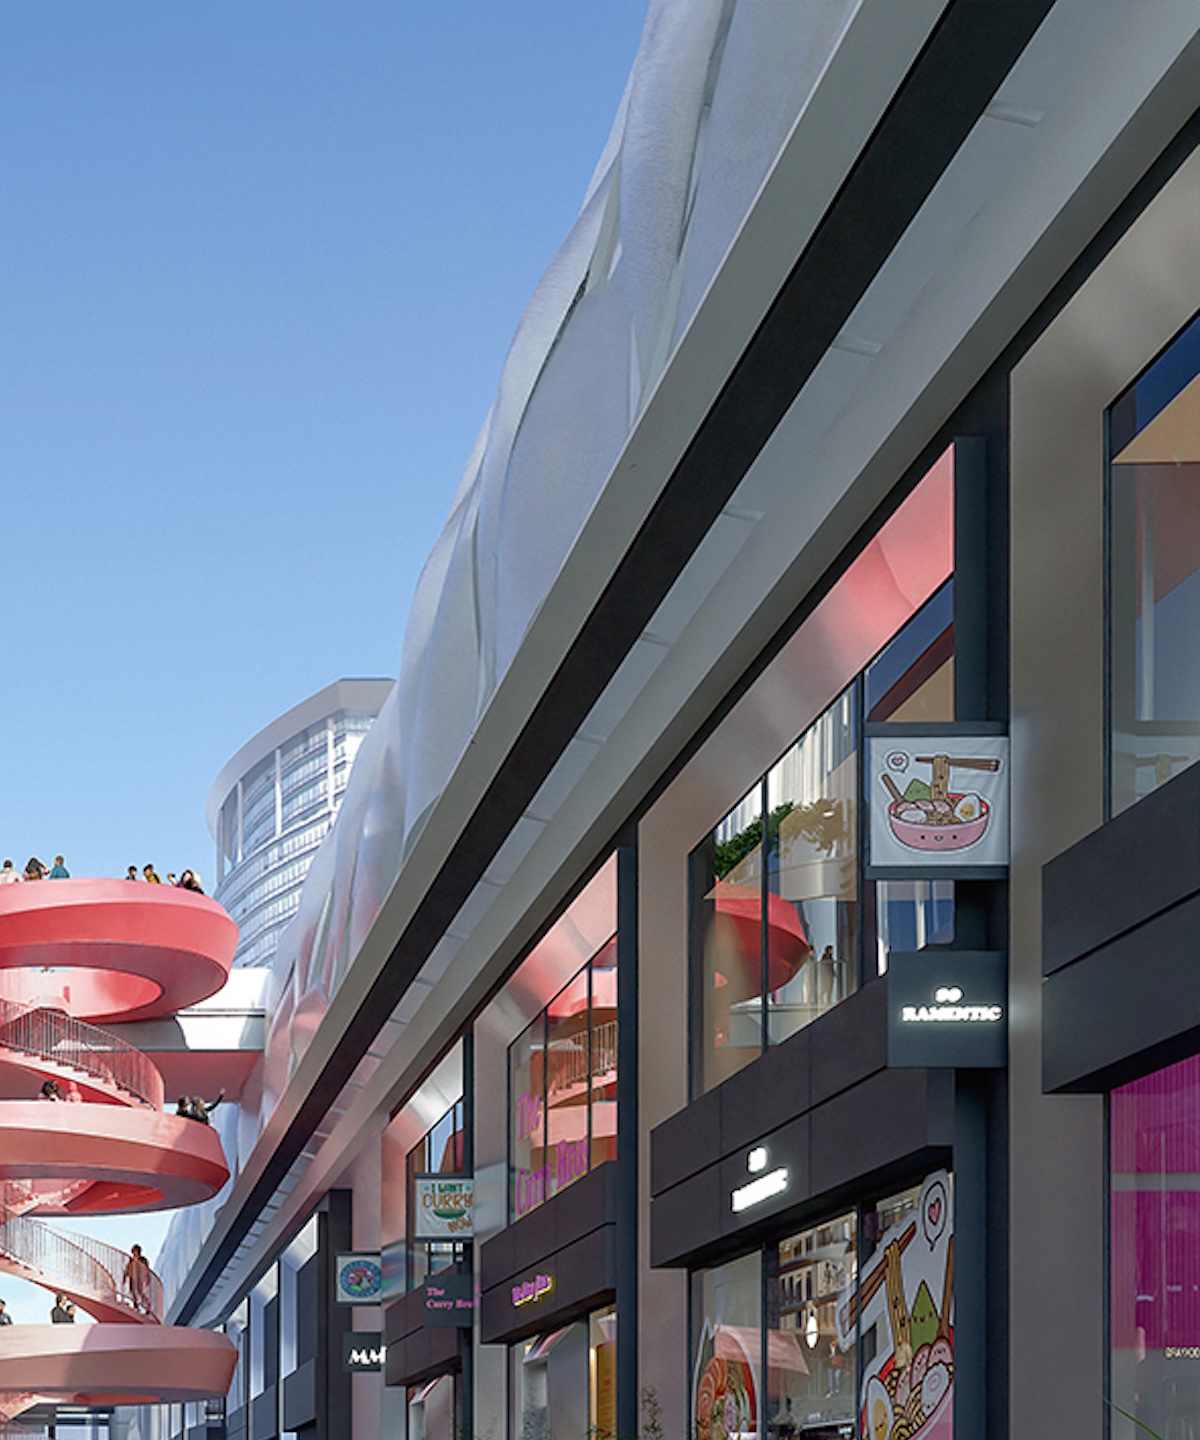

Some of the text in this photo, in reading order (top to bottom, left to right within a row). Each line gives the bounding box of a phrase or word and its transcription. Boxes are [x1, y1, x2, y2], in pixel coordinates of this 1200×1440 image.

[422, 1192, 473, 1209] CURRY
[426, 1287, 445, 1297] The
[426, 1298, 454, 1311] Curry
